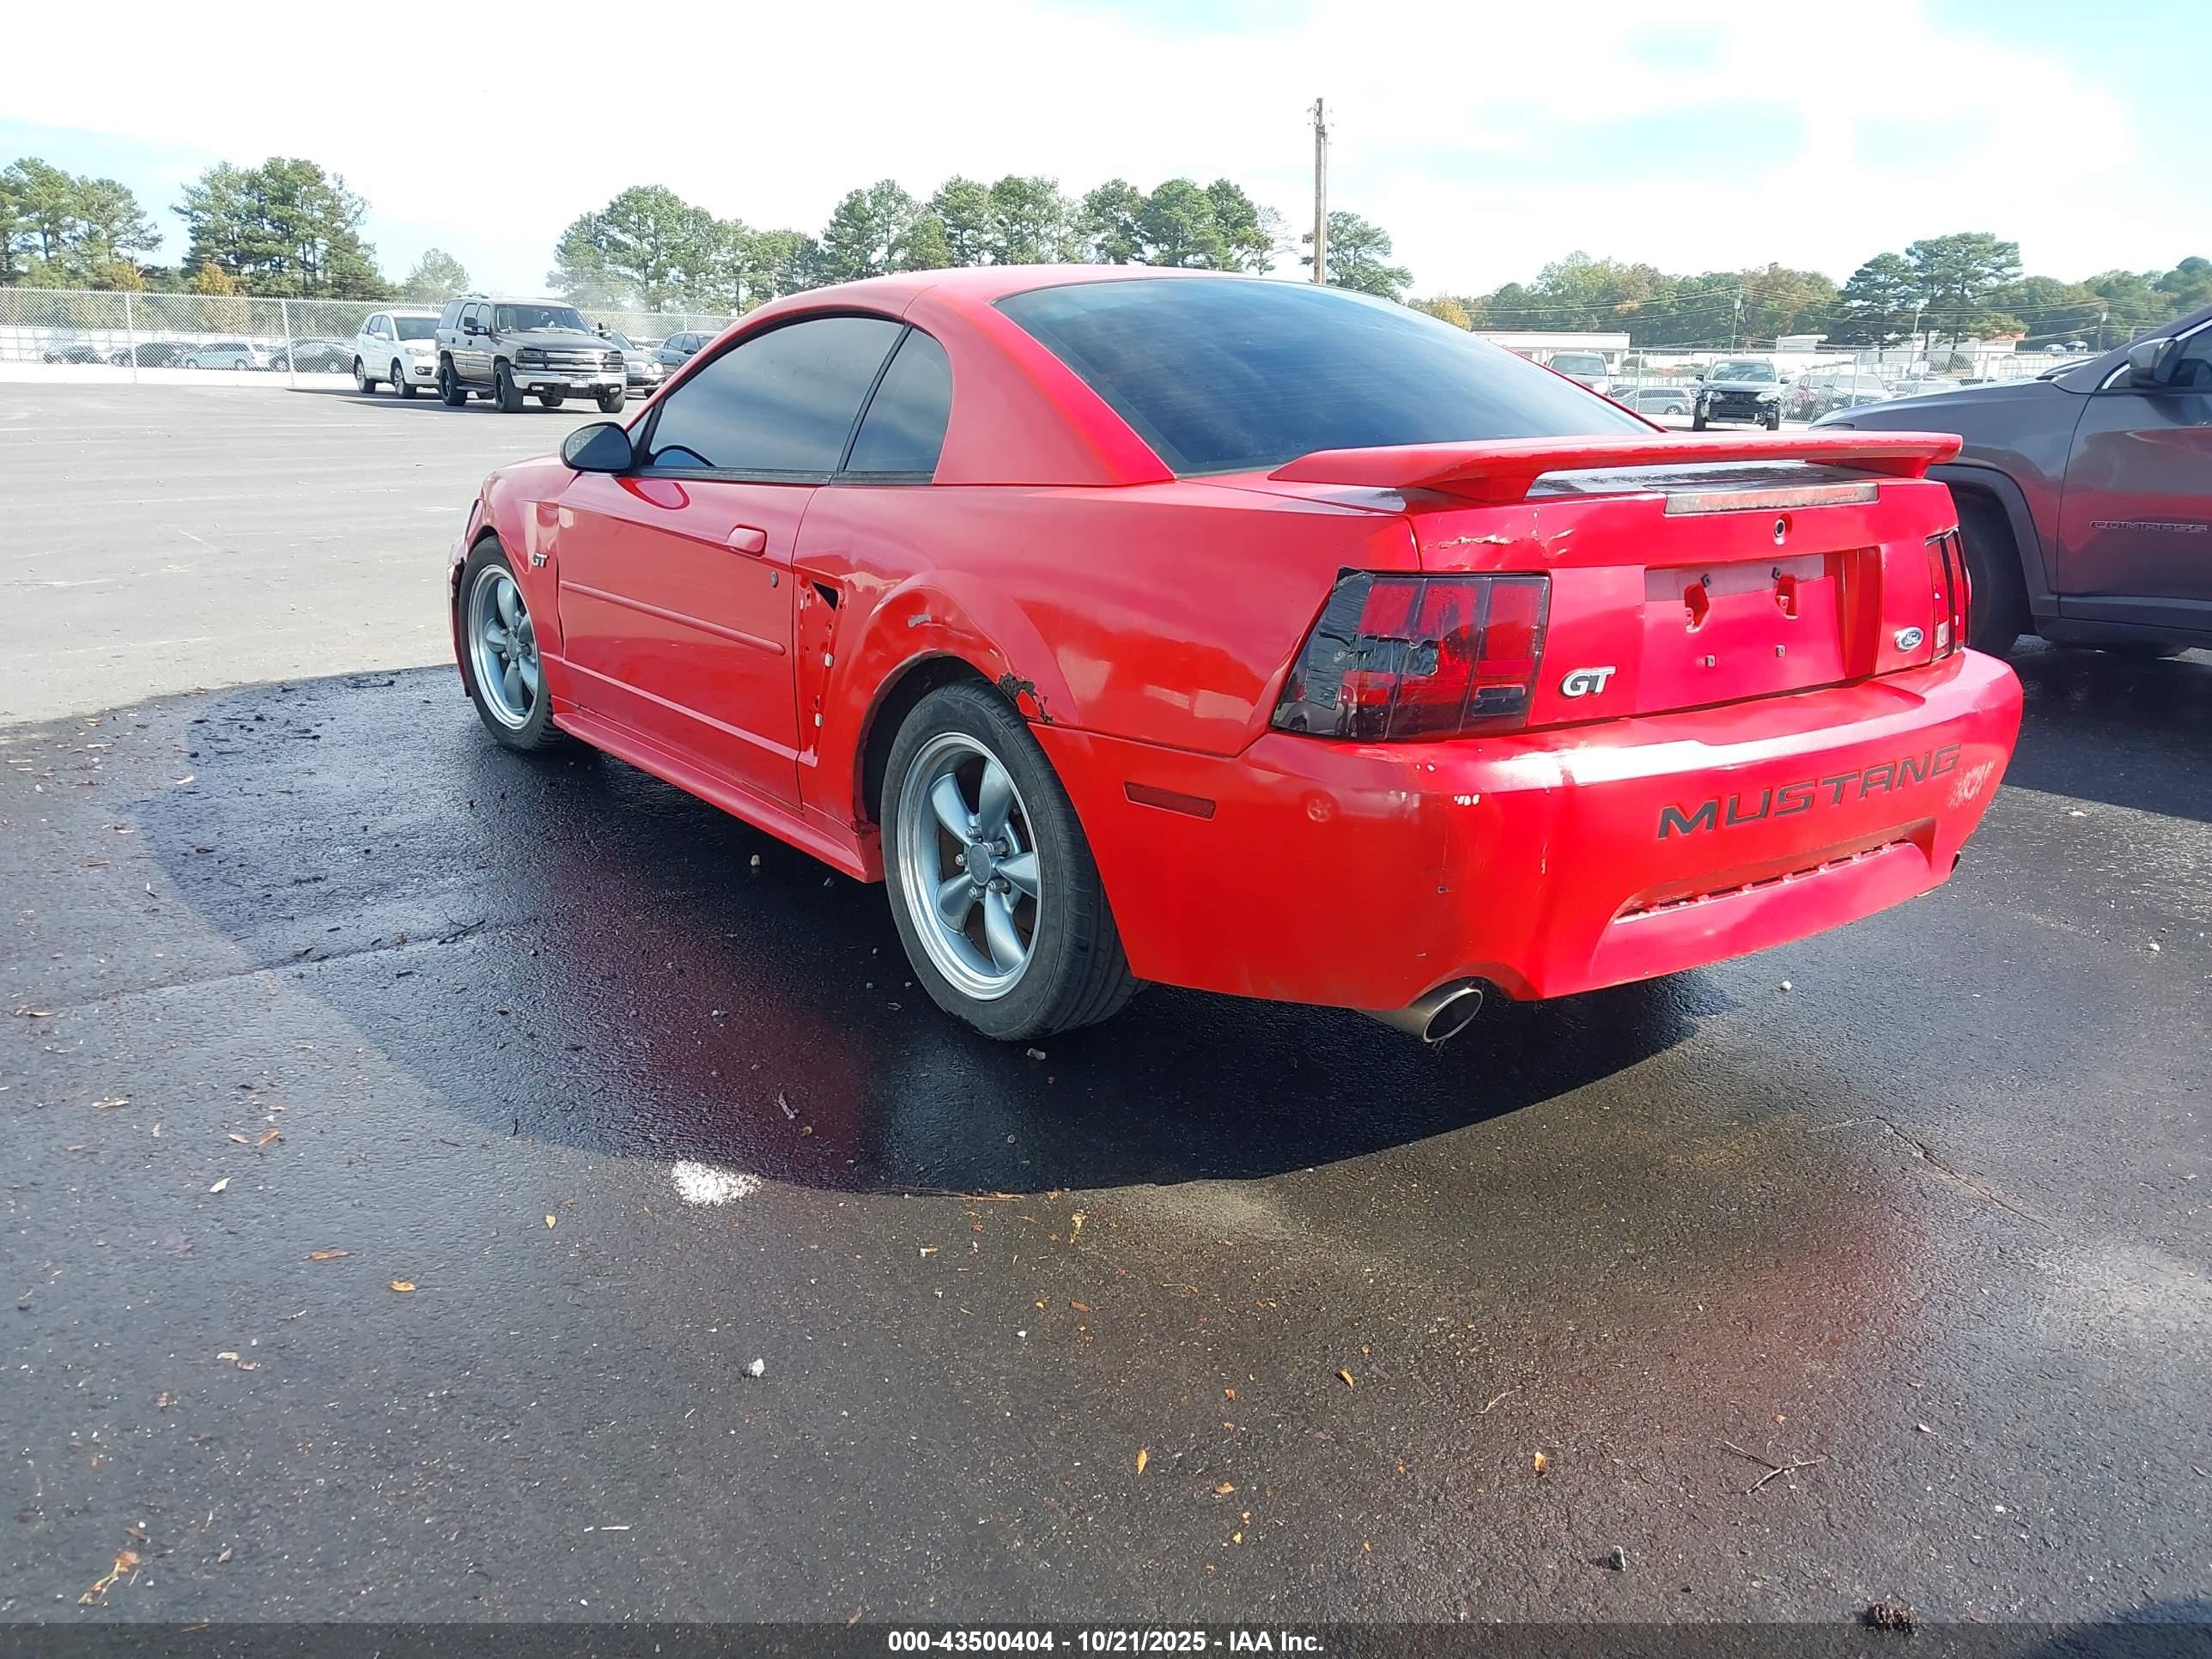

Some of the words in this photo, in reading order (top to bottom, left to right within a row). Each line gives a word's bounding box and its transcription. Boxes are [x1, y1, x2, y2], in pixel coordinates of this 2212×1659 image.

[2089, 520, 2209, 533] COMPASS
[531, 552, 550, 568] GT
[1561, 665, 1616, 696] GT
[1657, 744, 1961, 839] MUSTANG
